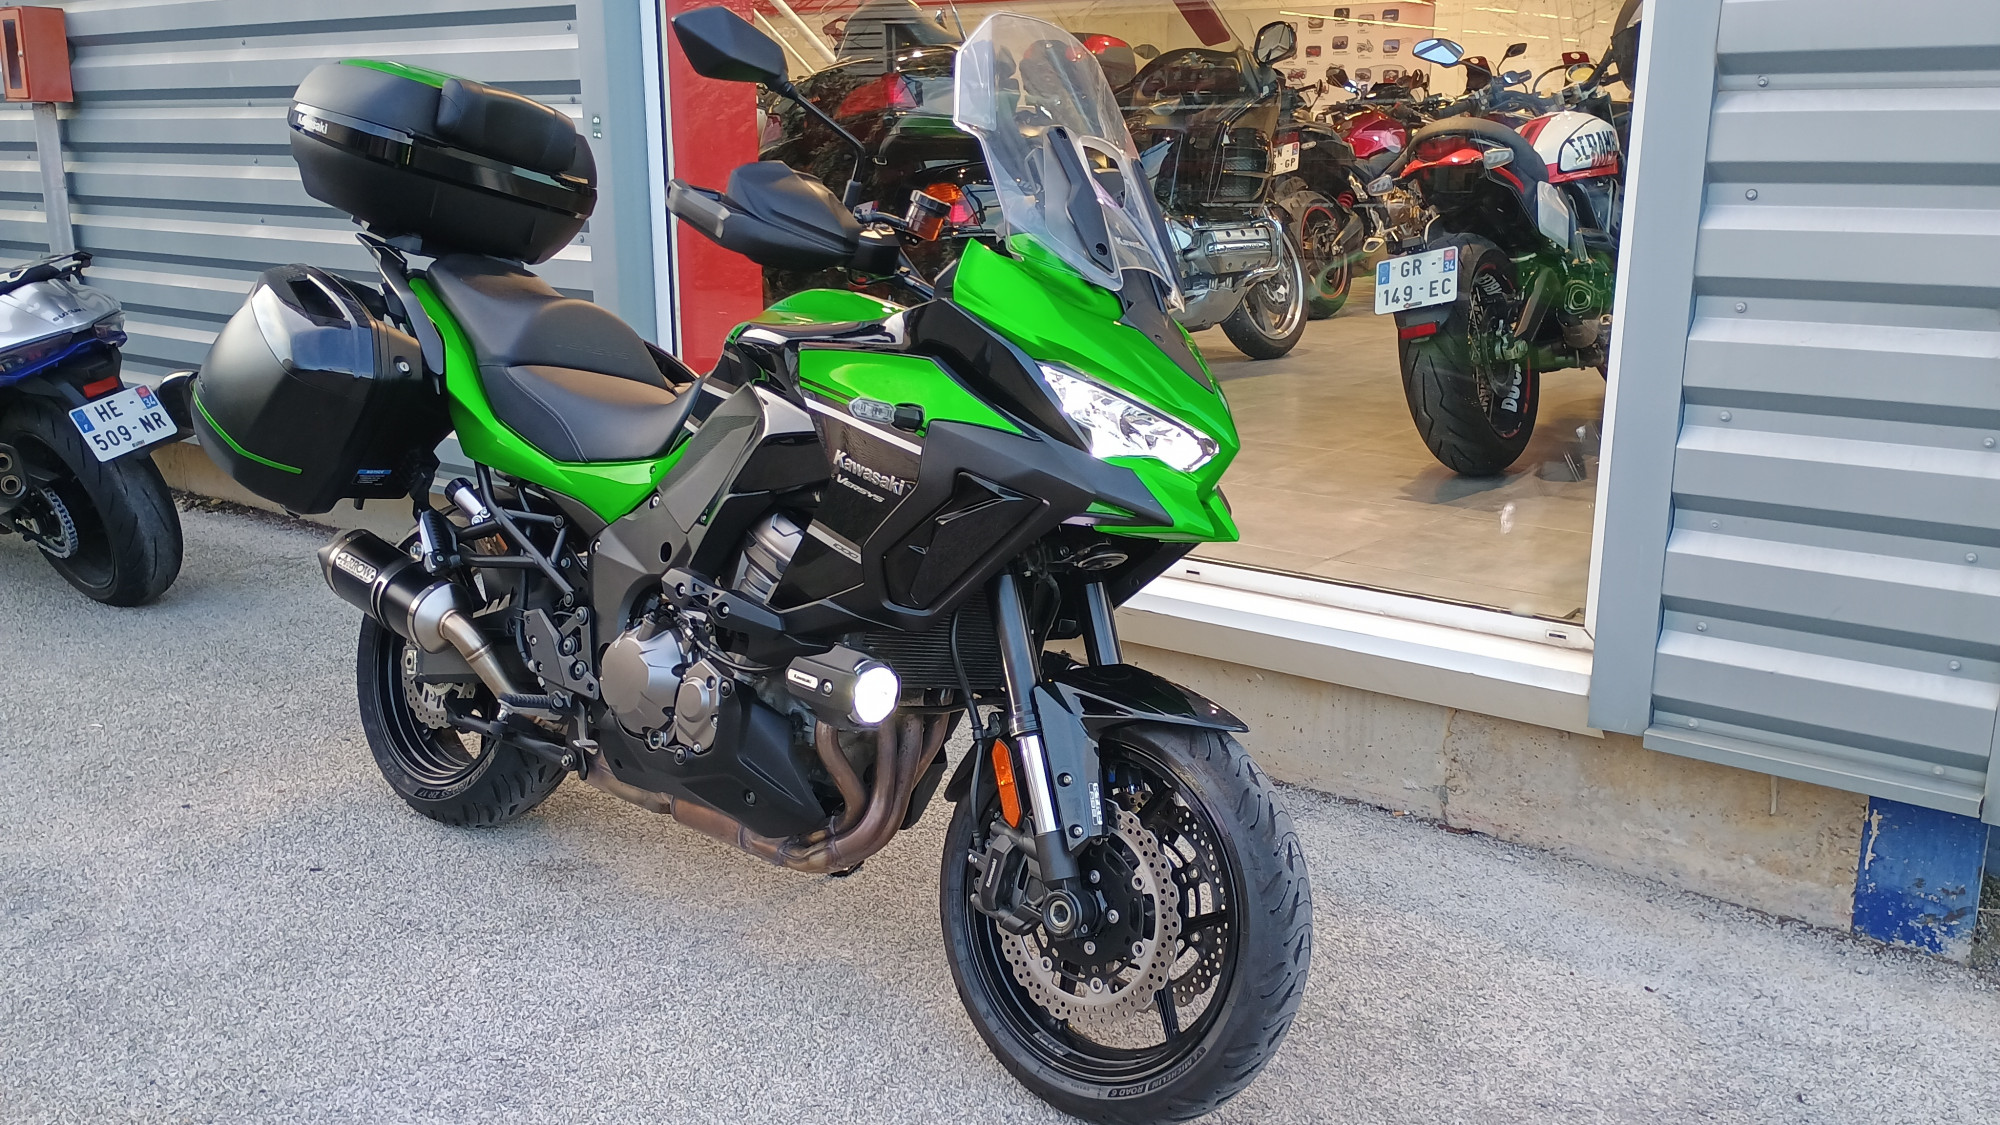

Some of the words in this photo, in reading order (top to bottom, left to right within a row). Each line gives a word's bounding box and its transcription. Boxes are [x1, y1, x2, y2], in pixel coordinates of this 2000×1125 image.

[1401, 259, 1422, 278] GR
[1444, 261, 1455, 271] 34
[94, 400, 123, 423] HE
[143, 398, 156, 408] 34
[833, 449, 905, 496] Kawasaki
[340, 554, 375, 578] ARROW
[1151, 1058, 1193, 1089] MICHELIN
[1110, 1088, 1117, 1098] 6
[1119, 1086, 1145, 1097] ROAD
